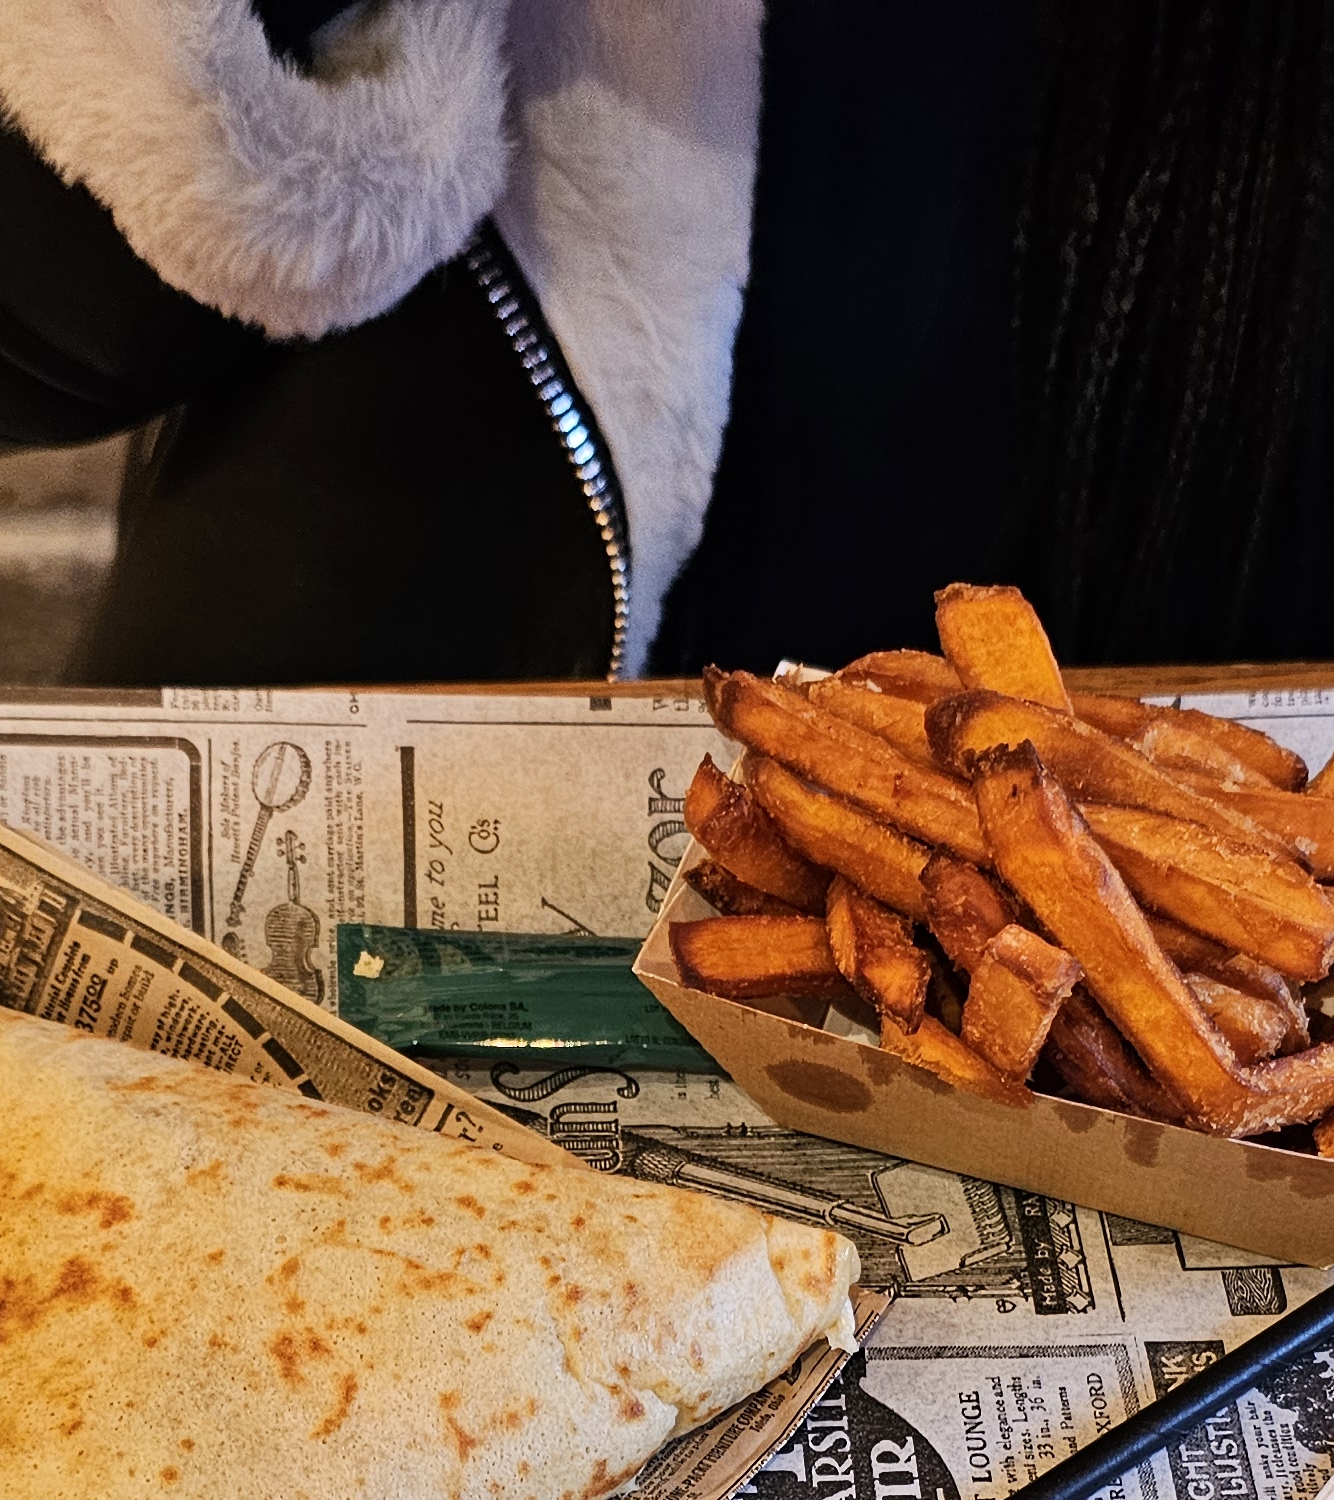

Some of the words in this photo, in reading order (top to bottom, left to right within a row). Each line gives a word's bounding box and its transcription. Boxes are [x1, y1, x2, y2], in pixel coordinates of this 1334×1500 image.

[427, 799, 452, 853] you
[424, 859, 445, 886] to
[959, 1391, 992, 1482] LOUNGE
[996, 1400, 1015, 1450] elegance
[1019, 1429, 1035, 1460] sizes.
